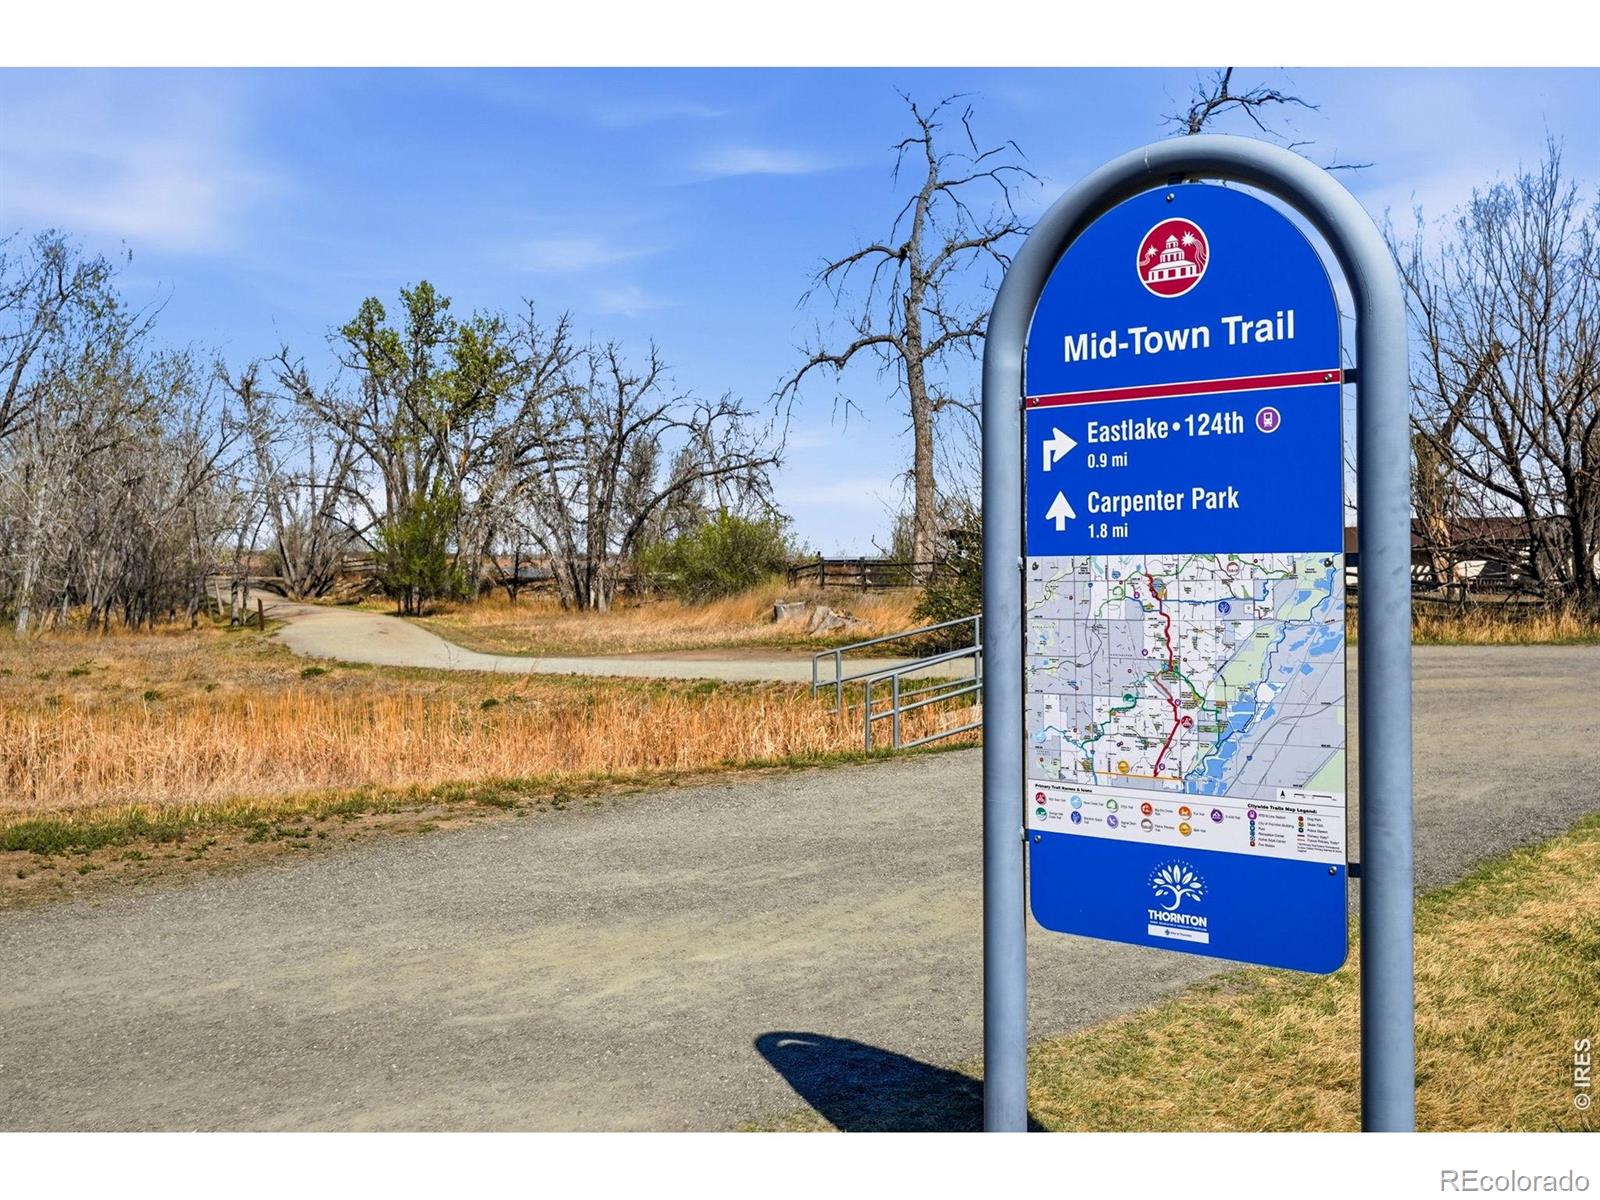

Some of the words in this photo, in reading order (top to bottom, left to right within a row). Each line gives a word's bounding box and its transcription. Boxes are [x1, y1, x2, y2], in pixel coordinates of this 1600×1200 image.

[1063, 326, 1210, 362] Mid-Town
[1221, 309, 1295, 345] Trail
[1087, 417, 1169, 443] Eastlake
[1184, 411, 1244, 437] 124th
[1087, 453, 1107, 469] 0.9
[1111, 452, 1128, 468] mi
[1087, 490, 1184, 517] Carpenter
[1191, 486, 1240, 510] Park
[1088, 523, 1107, 539] 1.8
[1112, 522, 1128, 538] mi
[1147, 908, 1208, 928] THORNTON
